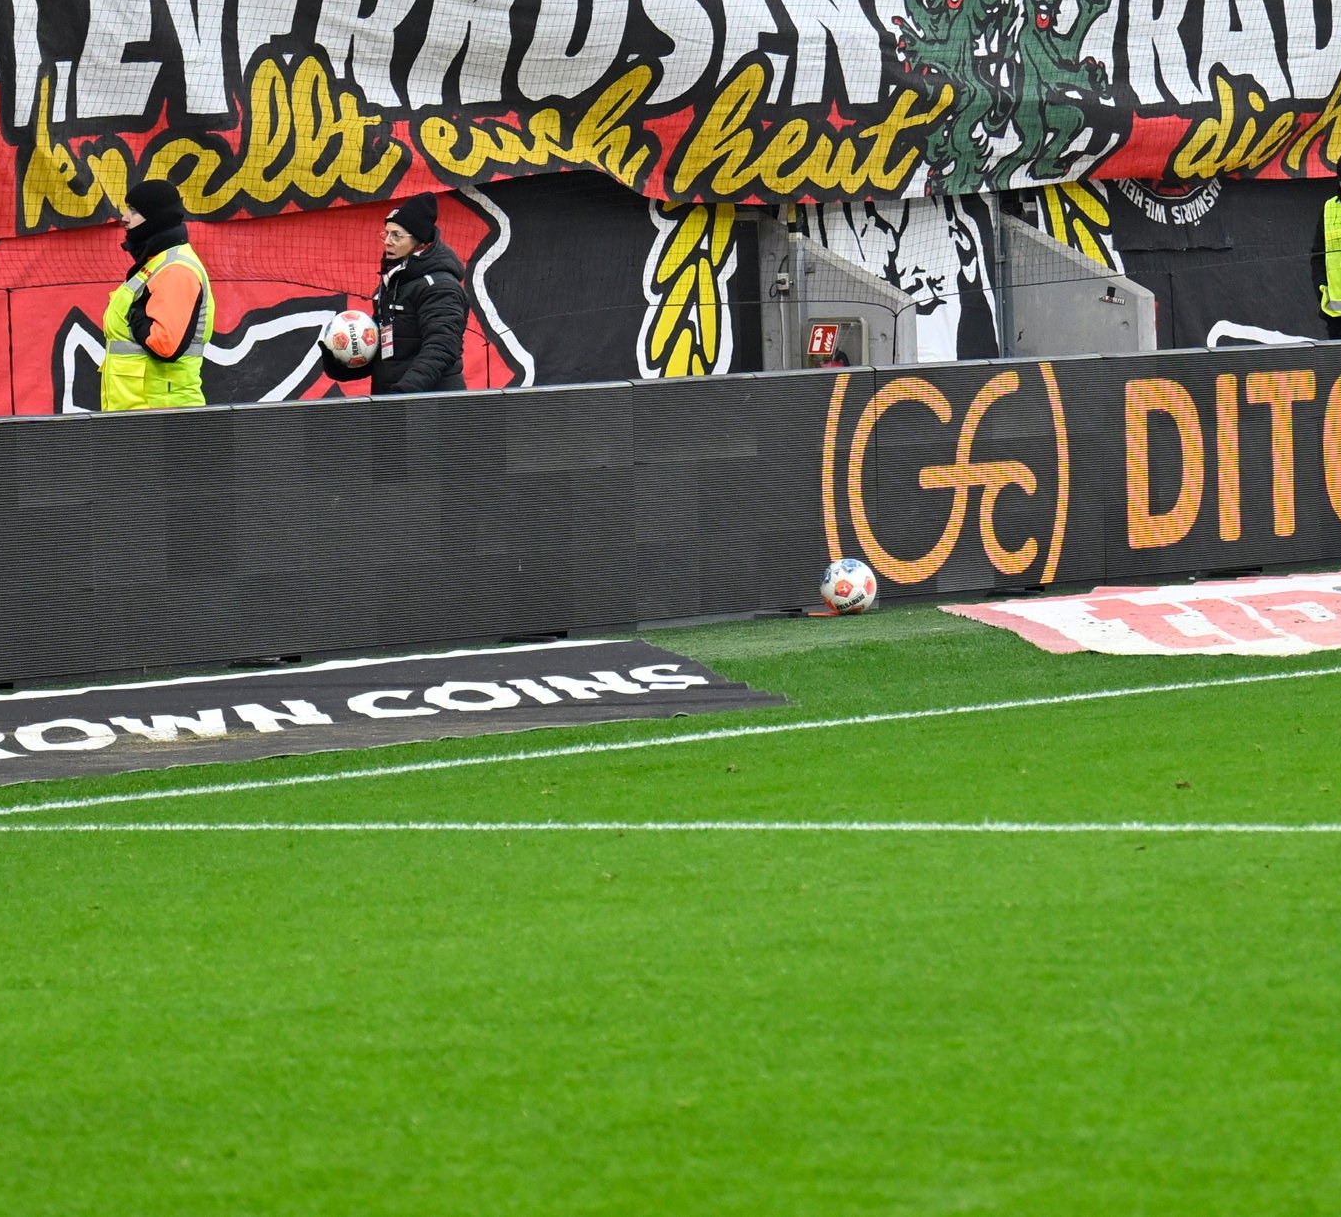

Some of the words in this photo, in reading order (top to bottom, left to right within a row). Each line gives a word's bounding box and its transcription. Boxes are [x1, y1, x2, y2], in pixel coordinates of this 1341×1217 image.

[22, 56, 403, 229] knallt
[419, 64, 652, 187] euch
[1173, 73, 1293, 179] die
[1144, 197, 1168, 225] WIE
[346, 663, 711, 719] COINS
